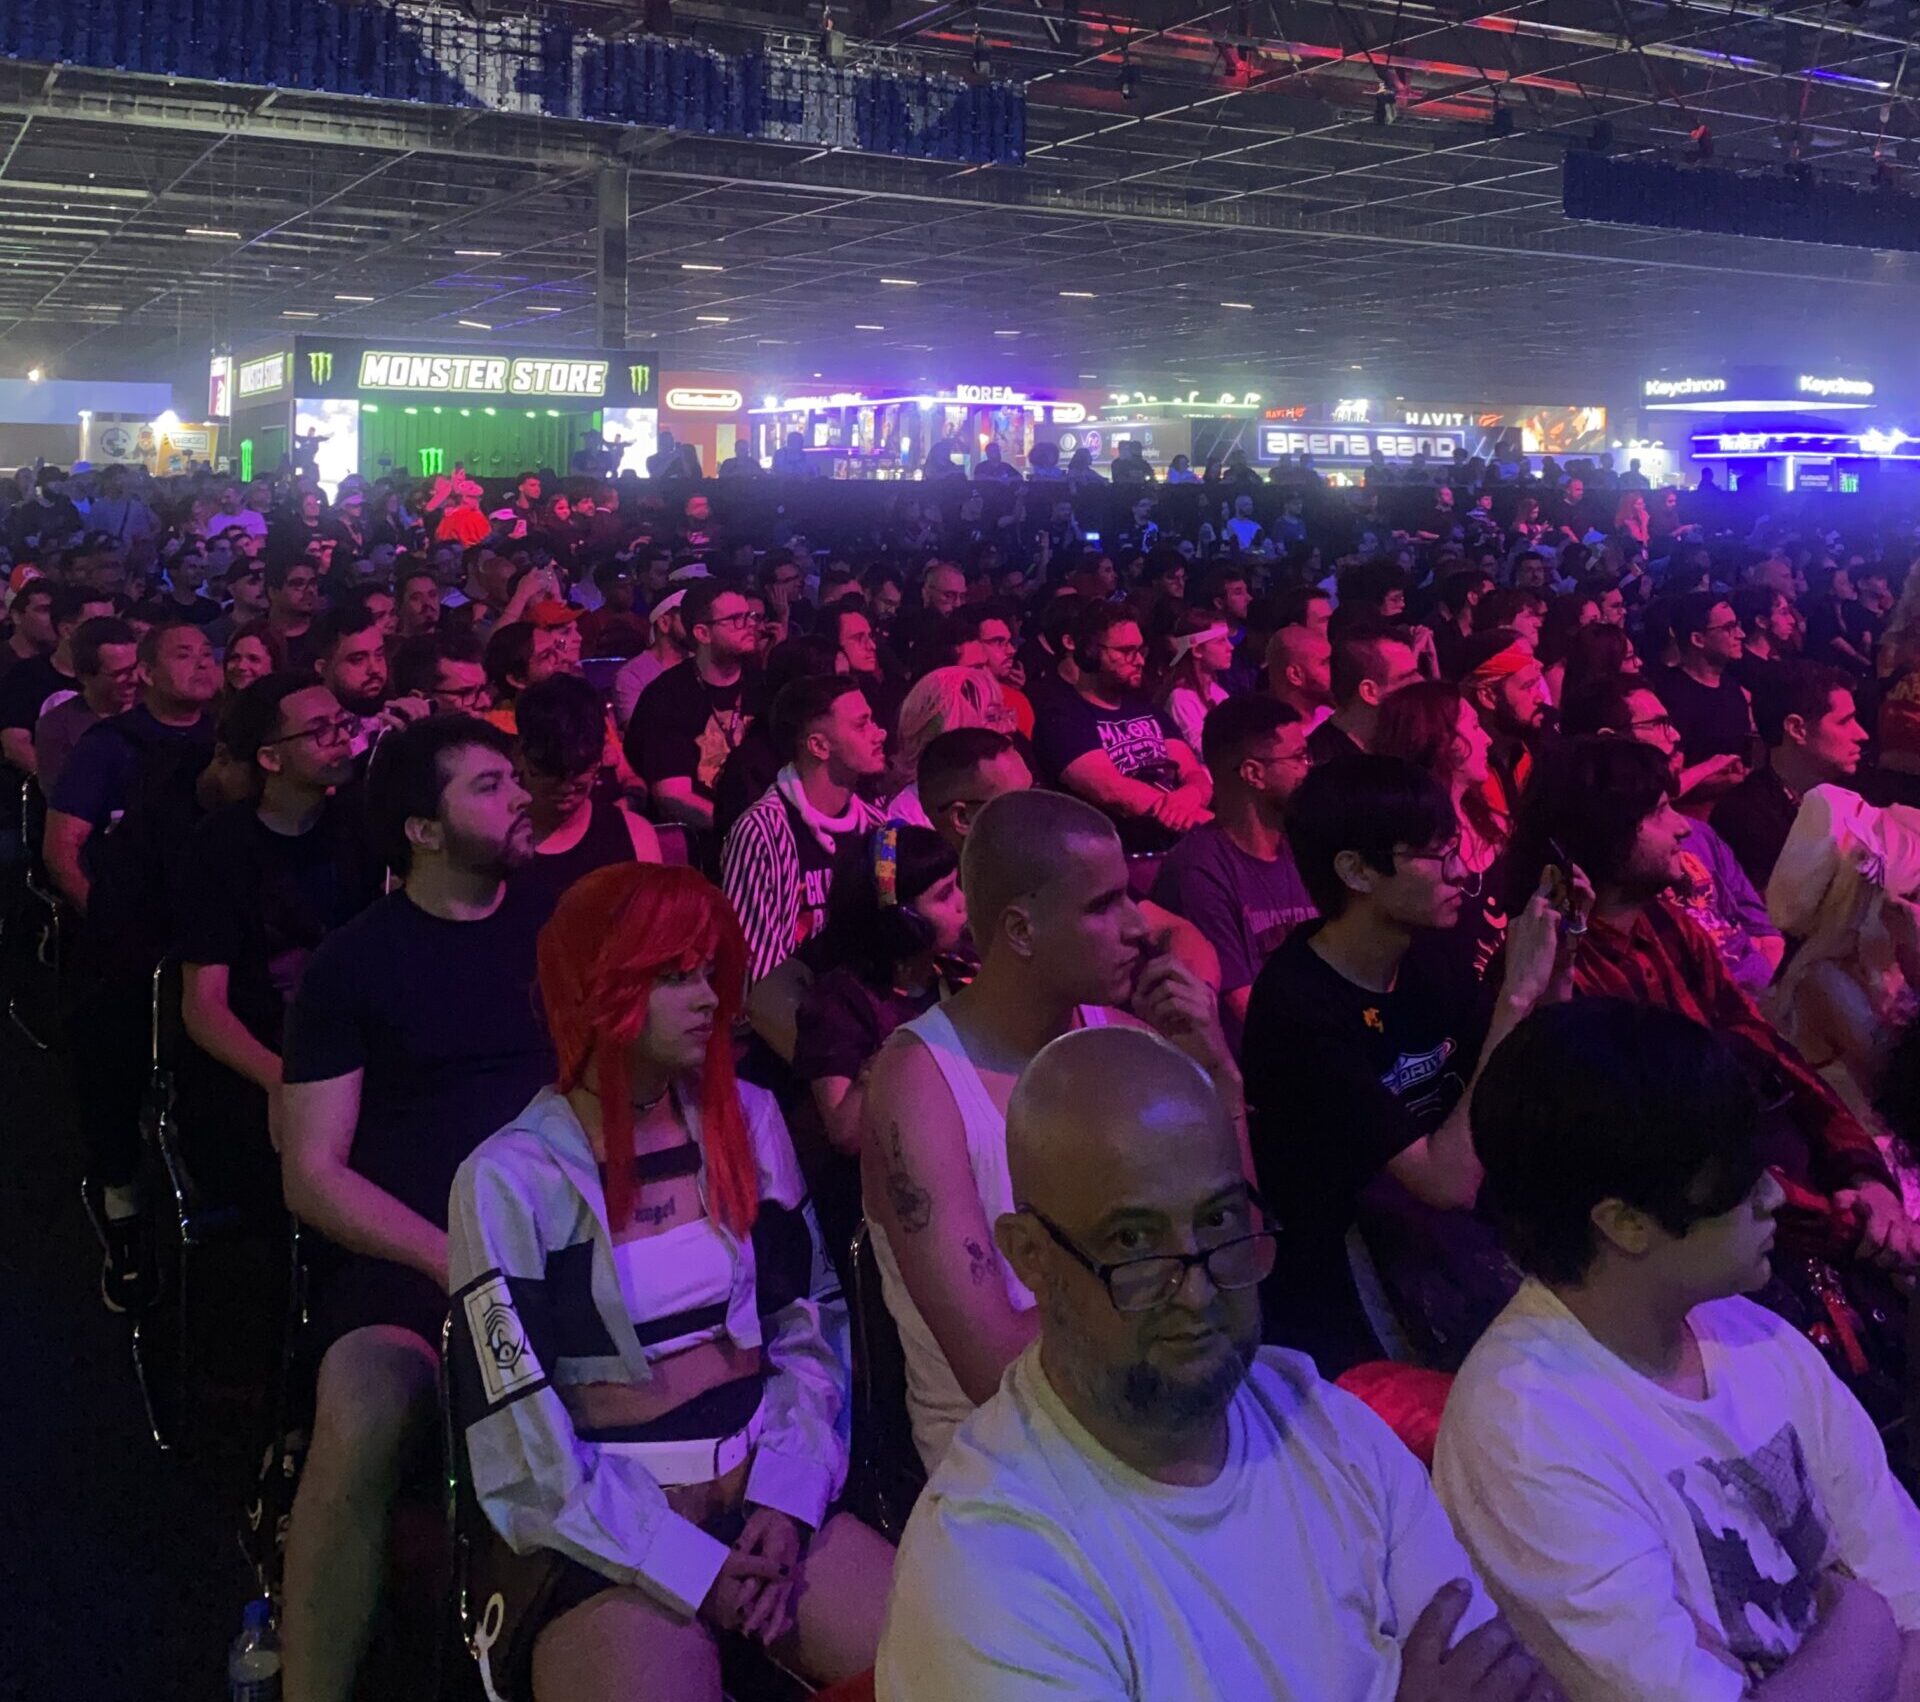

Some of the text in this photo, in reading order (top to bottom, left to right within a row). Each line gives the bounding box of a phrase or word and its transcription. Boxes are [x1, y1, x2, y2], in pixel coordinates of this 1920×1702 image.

[362, 353, 606, 394] MONSTER STORE
[956, 384, 1014, 401] KOREA
[1645, 378, 1726, 398] Keychron
[1405, 411, 1464, 426] HAVIT
